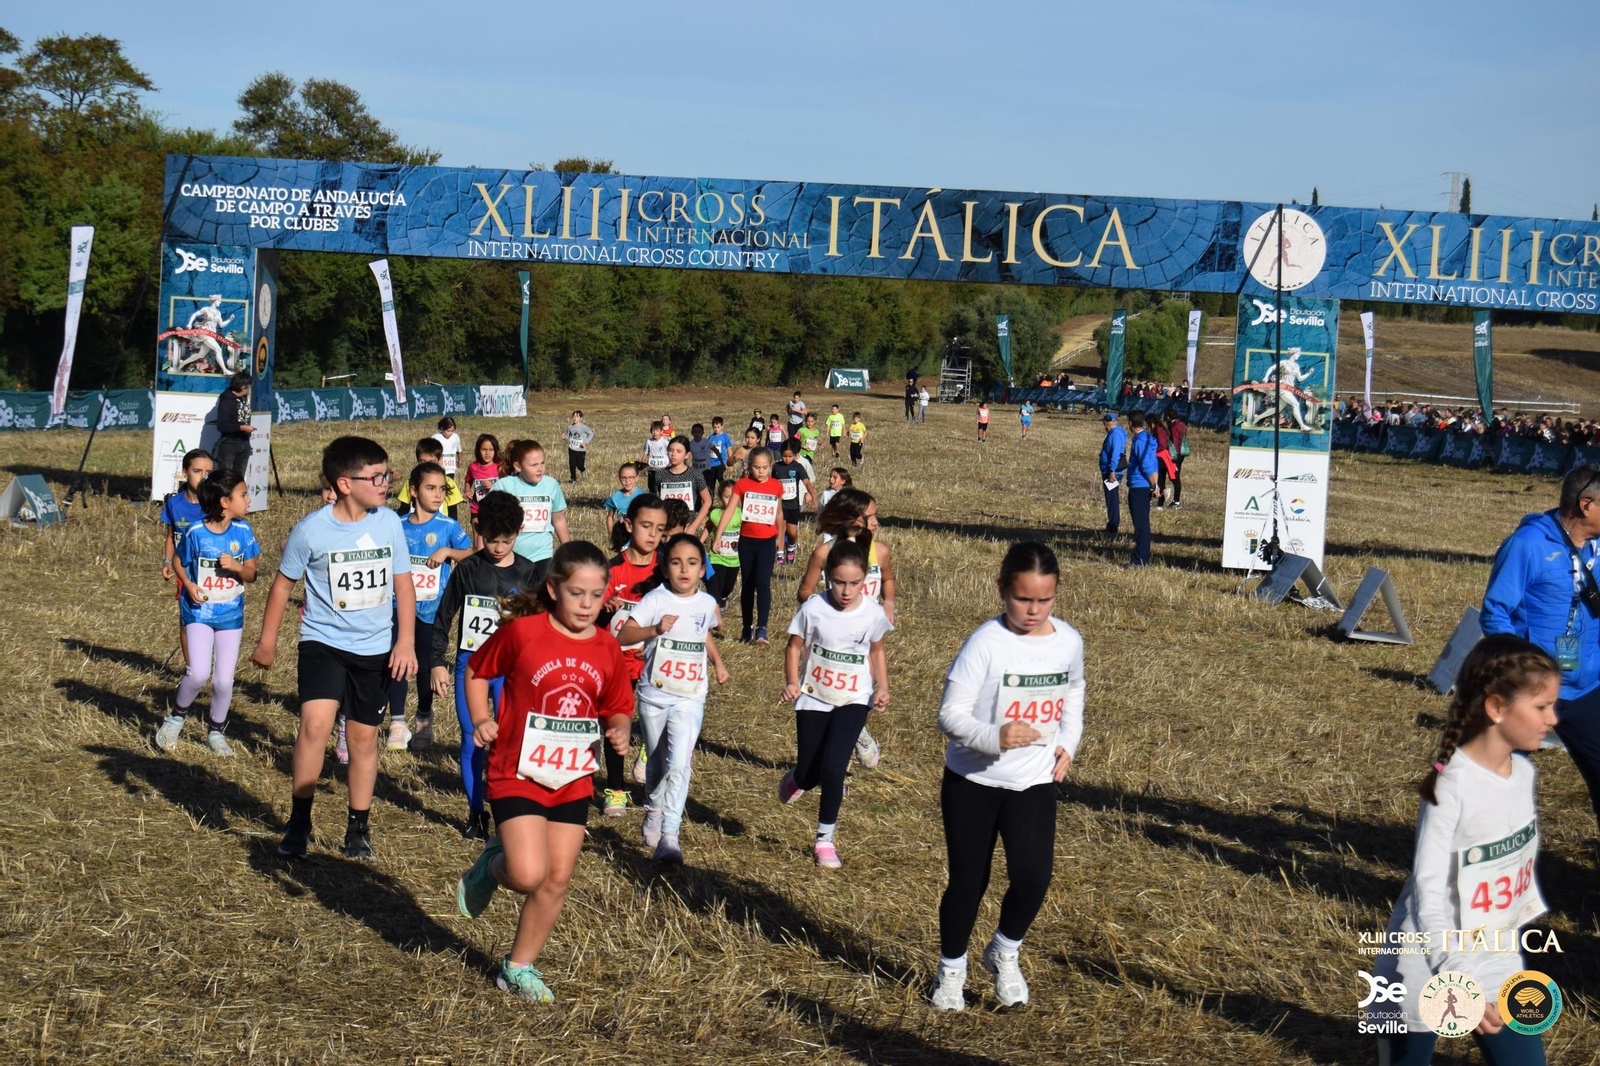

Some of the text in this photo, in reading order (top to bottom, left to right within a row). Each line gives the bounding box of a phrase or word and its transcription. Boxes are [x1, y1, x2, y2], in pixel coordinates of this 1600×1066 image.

[181, 184, 406, 206] CAMPEONATO DE ANDALUCÍA
[216, 200, 371, 219] DE CAMPO A TRAVÉS
[469, 182, 766, 242] XLIII CROSS
[250, 216, 339, 232] POR CLUBES
[824, 188, 1141, 270] ITÁLICA
[637, 226, 812, 250] INTERNACIONAL
[468, 240, 780, 269] INTERNATIONAL CROSS COUNTRY
[1372, 222, 1544, 286] XLIII
[210, 264, 244, 274] Sevilla
[1370, 282, 1596, 310] INTERNATIONAL CROSS
[1289, 316, 1324, 326] Sevilla
[1290, 308, 1325, 316] Diputación
[118, 411, 139, 425] Sevilla
[525, 509, 548, 521] 520
[746, 504, 774, 516] 4534
[203, 576, 239, 590] 445
[338, 568, 387, 591] 4311
[411, 574, 436, 589] 28
[860, 581, 877, 596] 47
[469, 616, 493, 635] 42
[531, 659, 562, 687] ESCUELA
[566, 658, 576, 667] DE
[660, 660, 704, 681] 4552
[811, 666, 859, 692] 4551
[1024, 676, 1057, 685] ITÁLICA
[1004, 698, 1064, 723] 4498
[551, 720, 586, 731] ITÁLICA
[529, 744, 595, 771] 4412
[1470, 858, 1532, 913] 4348
